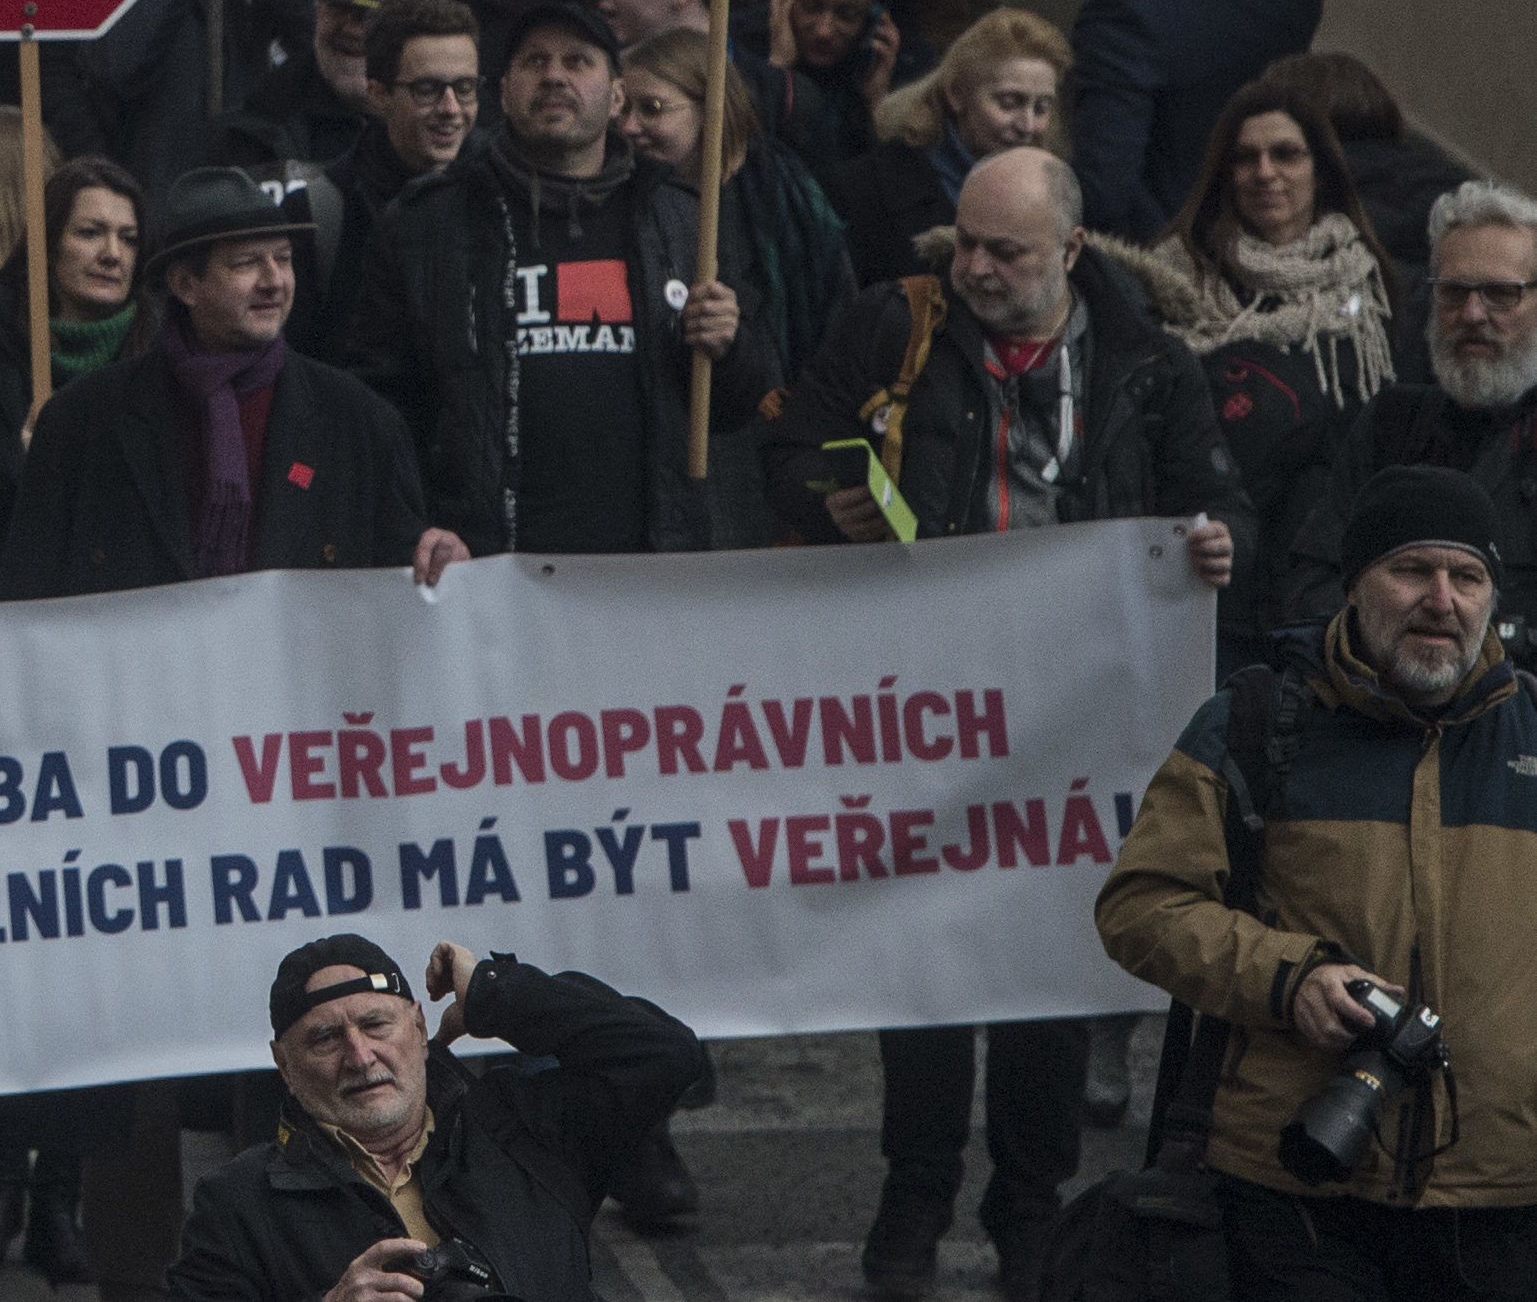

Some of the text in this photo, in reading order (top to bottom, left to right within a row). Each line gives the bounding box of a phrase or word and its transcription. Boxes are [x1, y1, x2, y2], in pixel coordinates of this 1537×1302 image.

[515, 263, 551, 324] I
[107, 739, 210, 817] DO
[231, 675, 1011, 805] VEŘEJNOPRÁVNÍCH
[210, 846, 375, 925] RAD
[397, 816, 522, 910] MÁ
[544, 807, 703, 901] BÝT
[728, 777, 1134, 889] VEŘEJNÁ!
